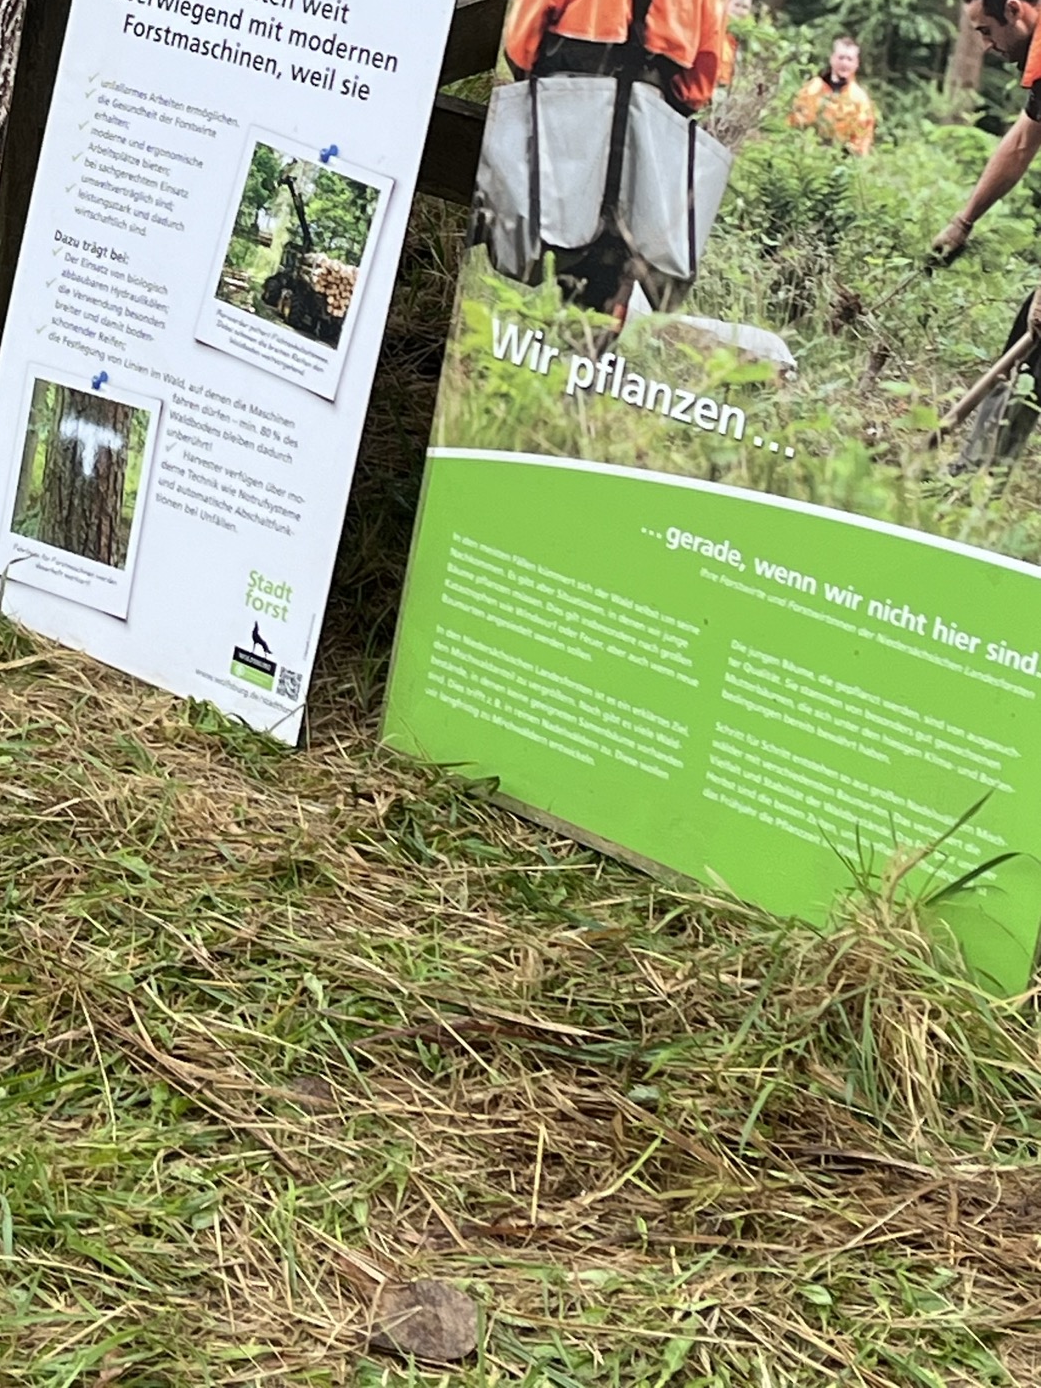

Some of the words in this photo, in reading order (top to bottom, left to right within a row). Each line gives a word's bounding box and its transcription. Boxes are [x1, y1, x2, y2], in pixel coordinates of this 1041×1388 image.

[124, 14, 281, 79] Forstmaschinen,
[292, 64, 336, 90] weil
[340, 75, 369, 100] sie
[249, 18, 283, 42] mit
[289, 29, 397, 72] modernen
[98, 95, 110, 106] die
[112, 98, 157, 119] Gesundheit
[159, 113, 173, 124] der
[175, 117, 216, 138] Forstwirte
[149, 93, 184, 110] Arbeiten
[91, 128, 127, 144] moderne
[129, 140, 145, 150] und
[146, 145, 203, 168] ergonomische
[84, 158, 96, 169] bei
[160, 181, 189, 198] Einsatz
[133, 209, 150, 220] und
[151, 214, 184, 231] dadurch
[54, 230, 79, 248] Dazu
[83, 240, 108, 259] trägt
[110, 248, 129, 264] bei:
[65, 252, 79, 264] Der
[81, 258, 109, 275] Einsatz
[110, 270, 125, 280] von
[127, 274, 168, 294] biologisch
[55, 300, 81, 315] breiter
[83, 312, 100, 323] und
[100, 317, 124, 332] damit
[58, 285, 70, 295] die
[73, 289, 123, 316] Verwendung
[125, 307, 165, 329] besonders
[52, 317, 96, 338] schonender
[492, 317, 559, 378] Wir
[48, 332, 61, 343] die
[63, 336, 105, 361] Festlegung
[107, 355, 122, 365] von
[124, 359, 148, 374] Linien
[151, 368, 161, 379] im
[189, 384, 203, 394] auf
[205, 389, 231, 405] denen
[233, 400, 246, 411] die
[249, 404, 295, 428] Maschinen
[173, 393, 199, 411] fahren
[202, 406, 230, 423] dürfen
[283, 436, 298, 448] des
[223, 431, 254, 449] bleiben
[257, 444, 292, 463] dadurch
[158, 478, 175, 490] und
[176, 485, 233, 513] automatische
[188, 469, 218, 489] Technik
[221, 485, 236, 496] wie
[225, 468, 263, 488] verfügen
[265, 483, 286, 497] über
[184, 504, 198, 515] bei
[248, 570, 292, 603] Stadt
[666, 527, 746, 571] gerade,
[754, 558, 817, 595] wenn
[824, 583, 863, 610] wir
[868, 600, 927, 635] nicht
[932, 617, 979, 653] hier
[986, 641, 1041, 678] sind.
[245, 589, 288, 622] forst
